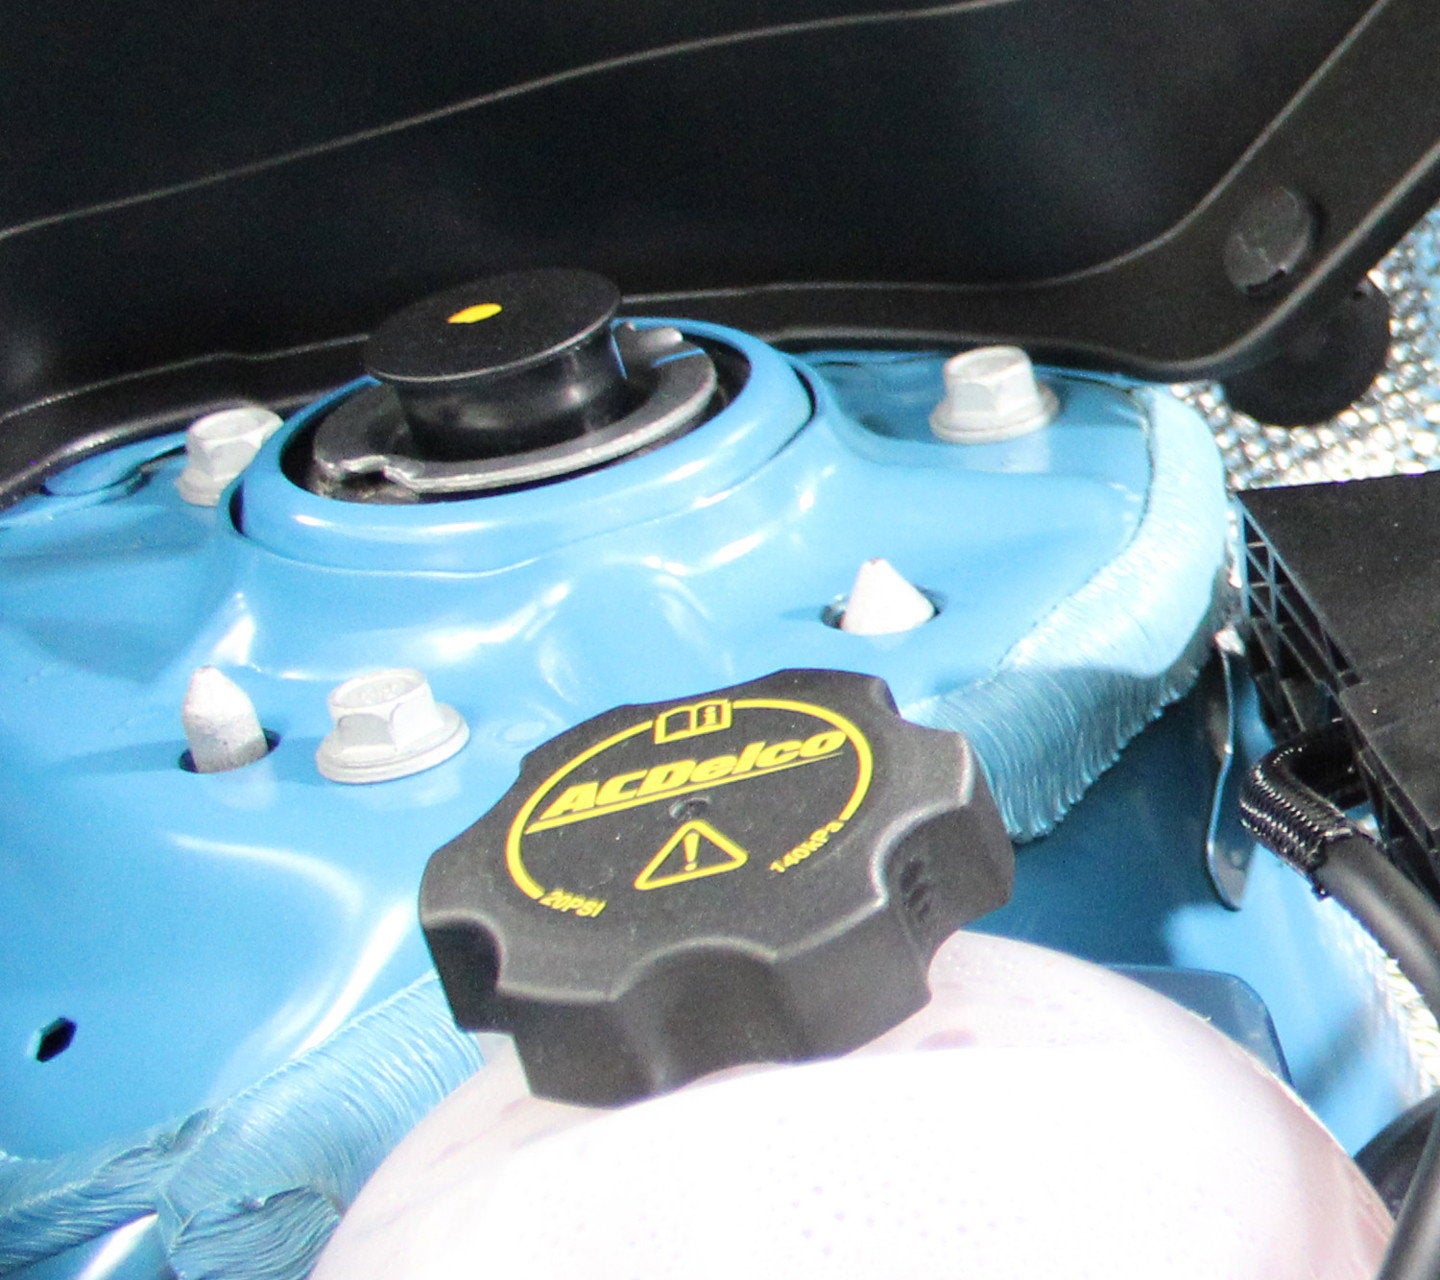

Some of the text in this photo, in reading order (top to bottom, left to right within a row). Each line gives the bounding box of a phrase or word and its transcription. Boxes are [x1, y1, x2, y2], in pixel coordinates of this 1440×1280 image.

[538, 730, 848, 821] ACDelco
[769, 820, 845, 873] 140kPa
[539, 888, 607, 918] 20PSI
